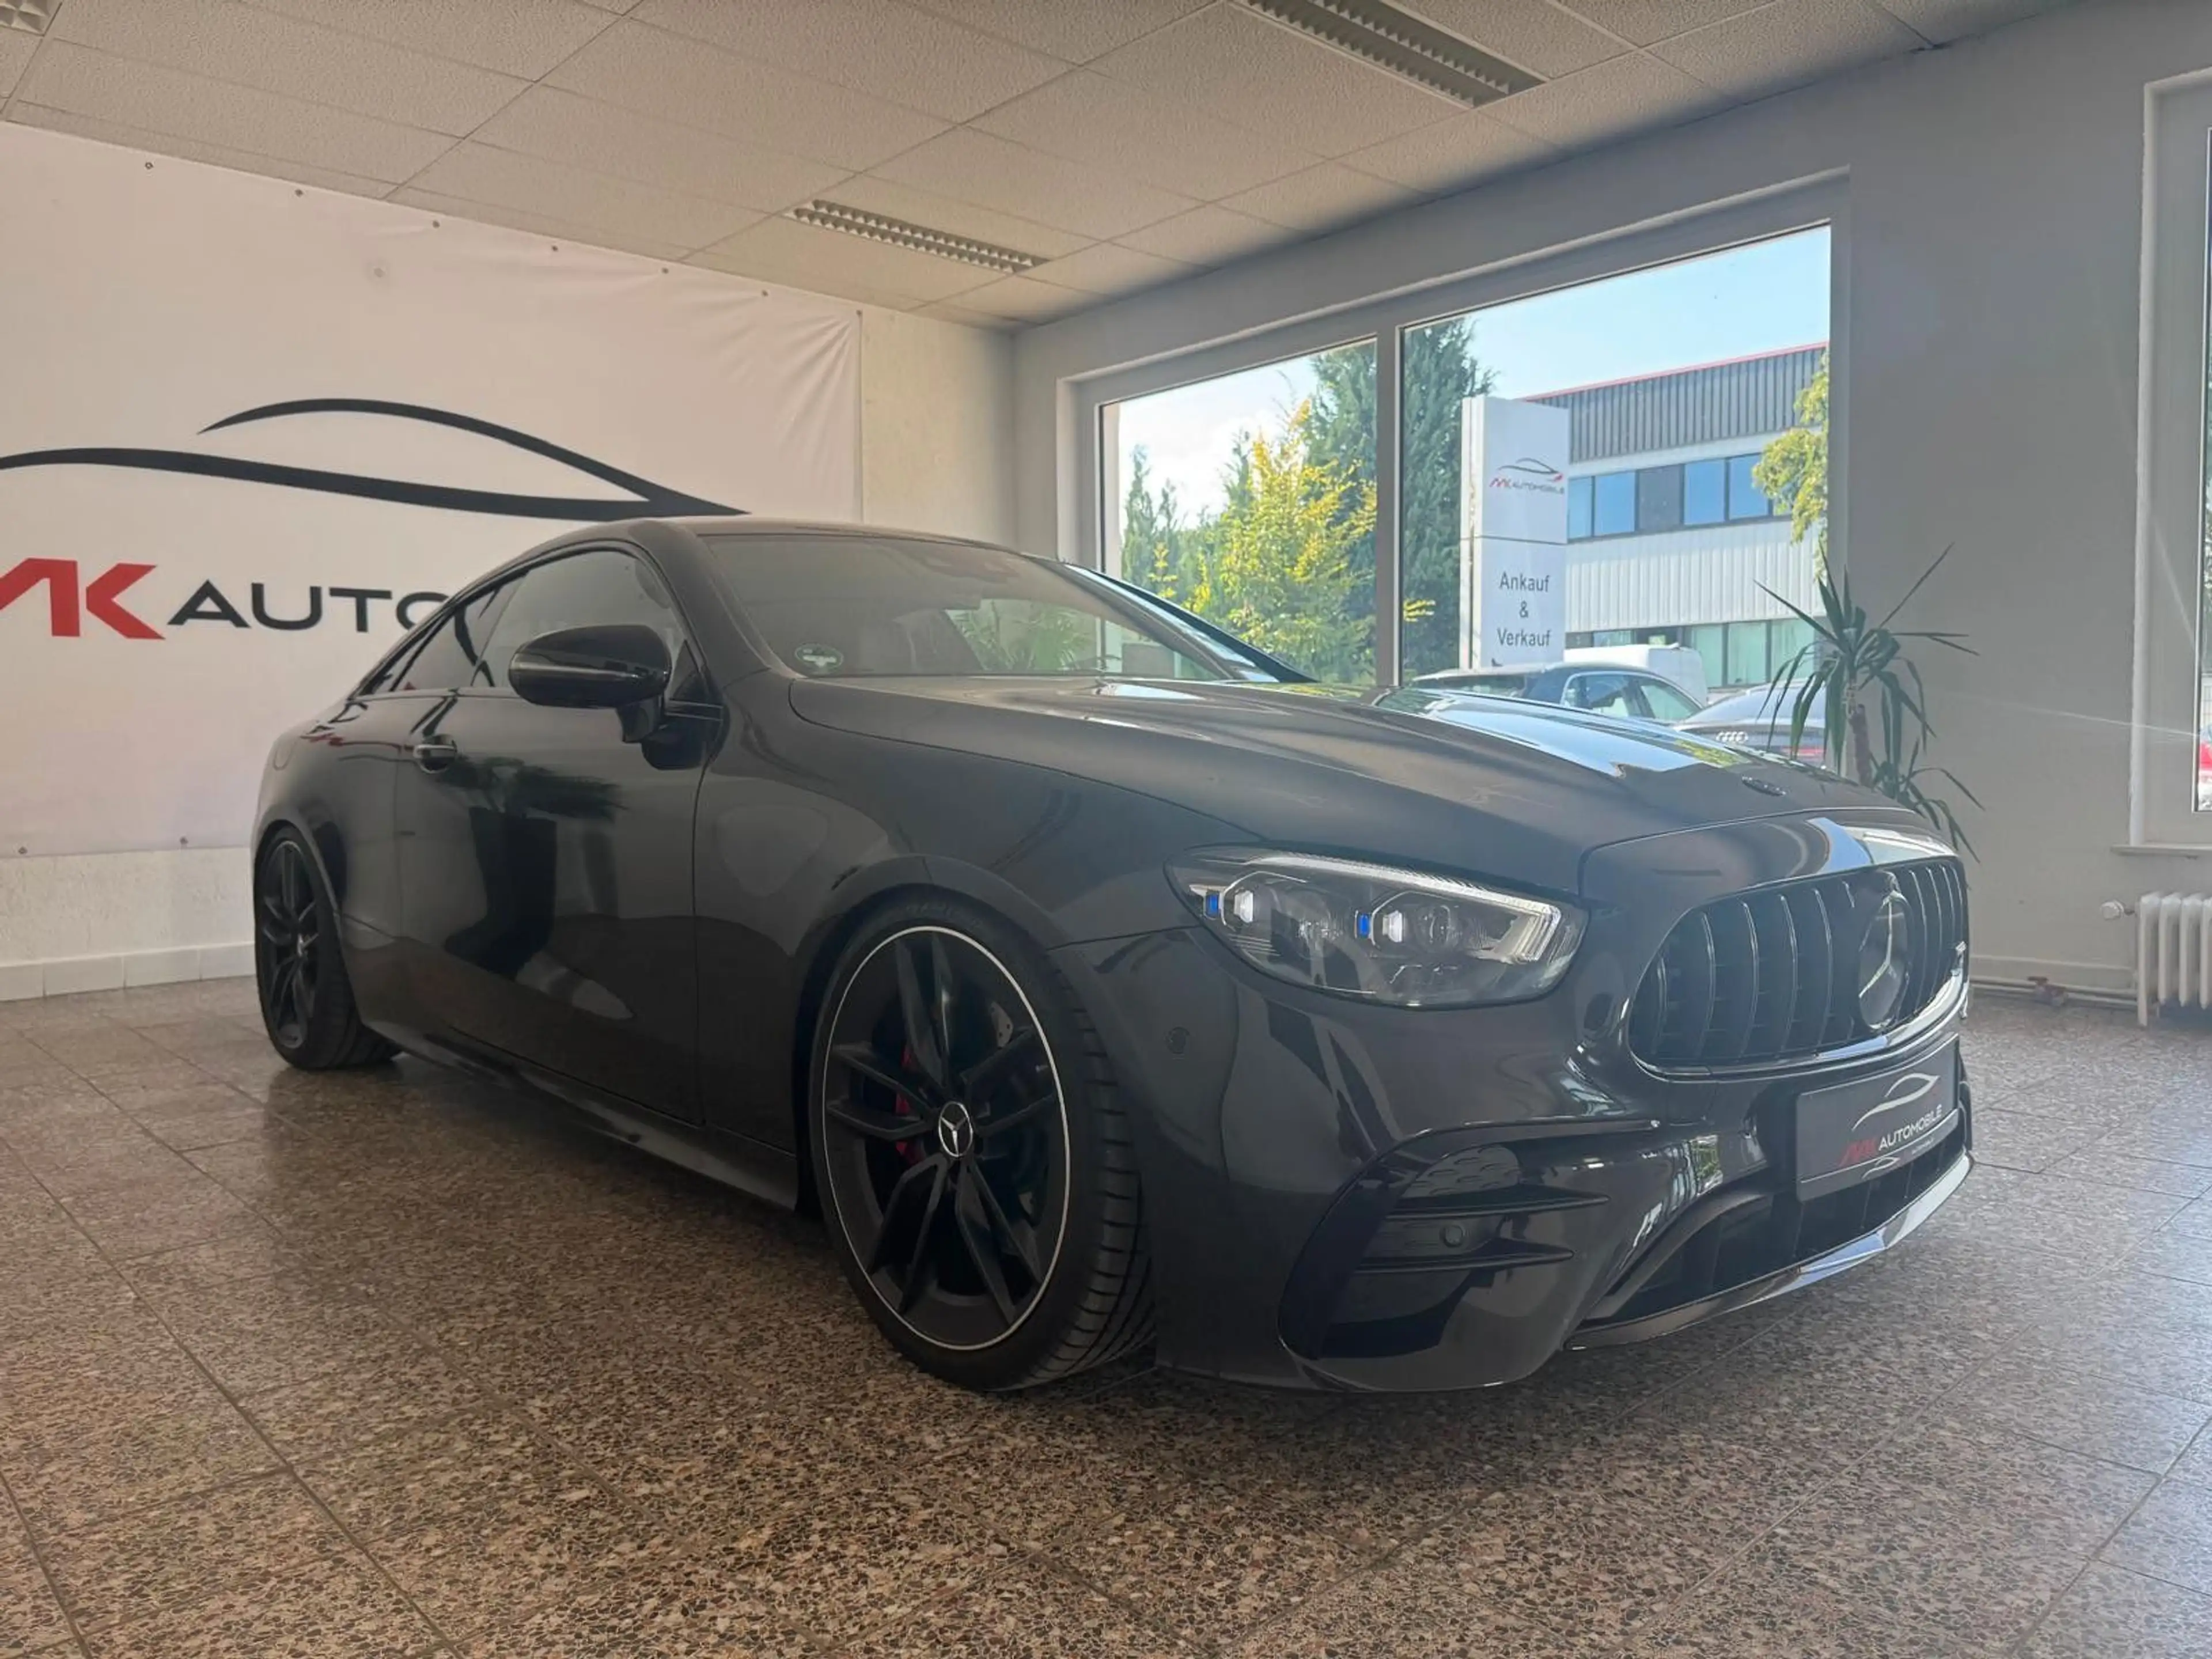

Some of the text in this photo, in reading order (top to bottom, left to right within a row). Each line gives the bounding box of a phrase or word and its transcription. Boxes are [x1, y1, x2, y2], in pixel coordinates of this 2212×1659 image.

[1499, 572, 1550, 592] Ankauf
[1519, 601, 1529, 618] &
[1497, 628, 1552, 647] Verkauf
